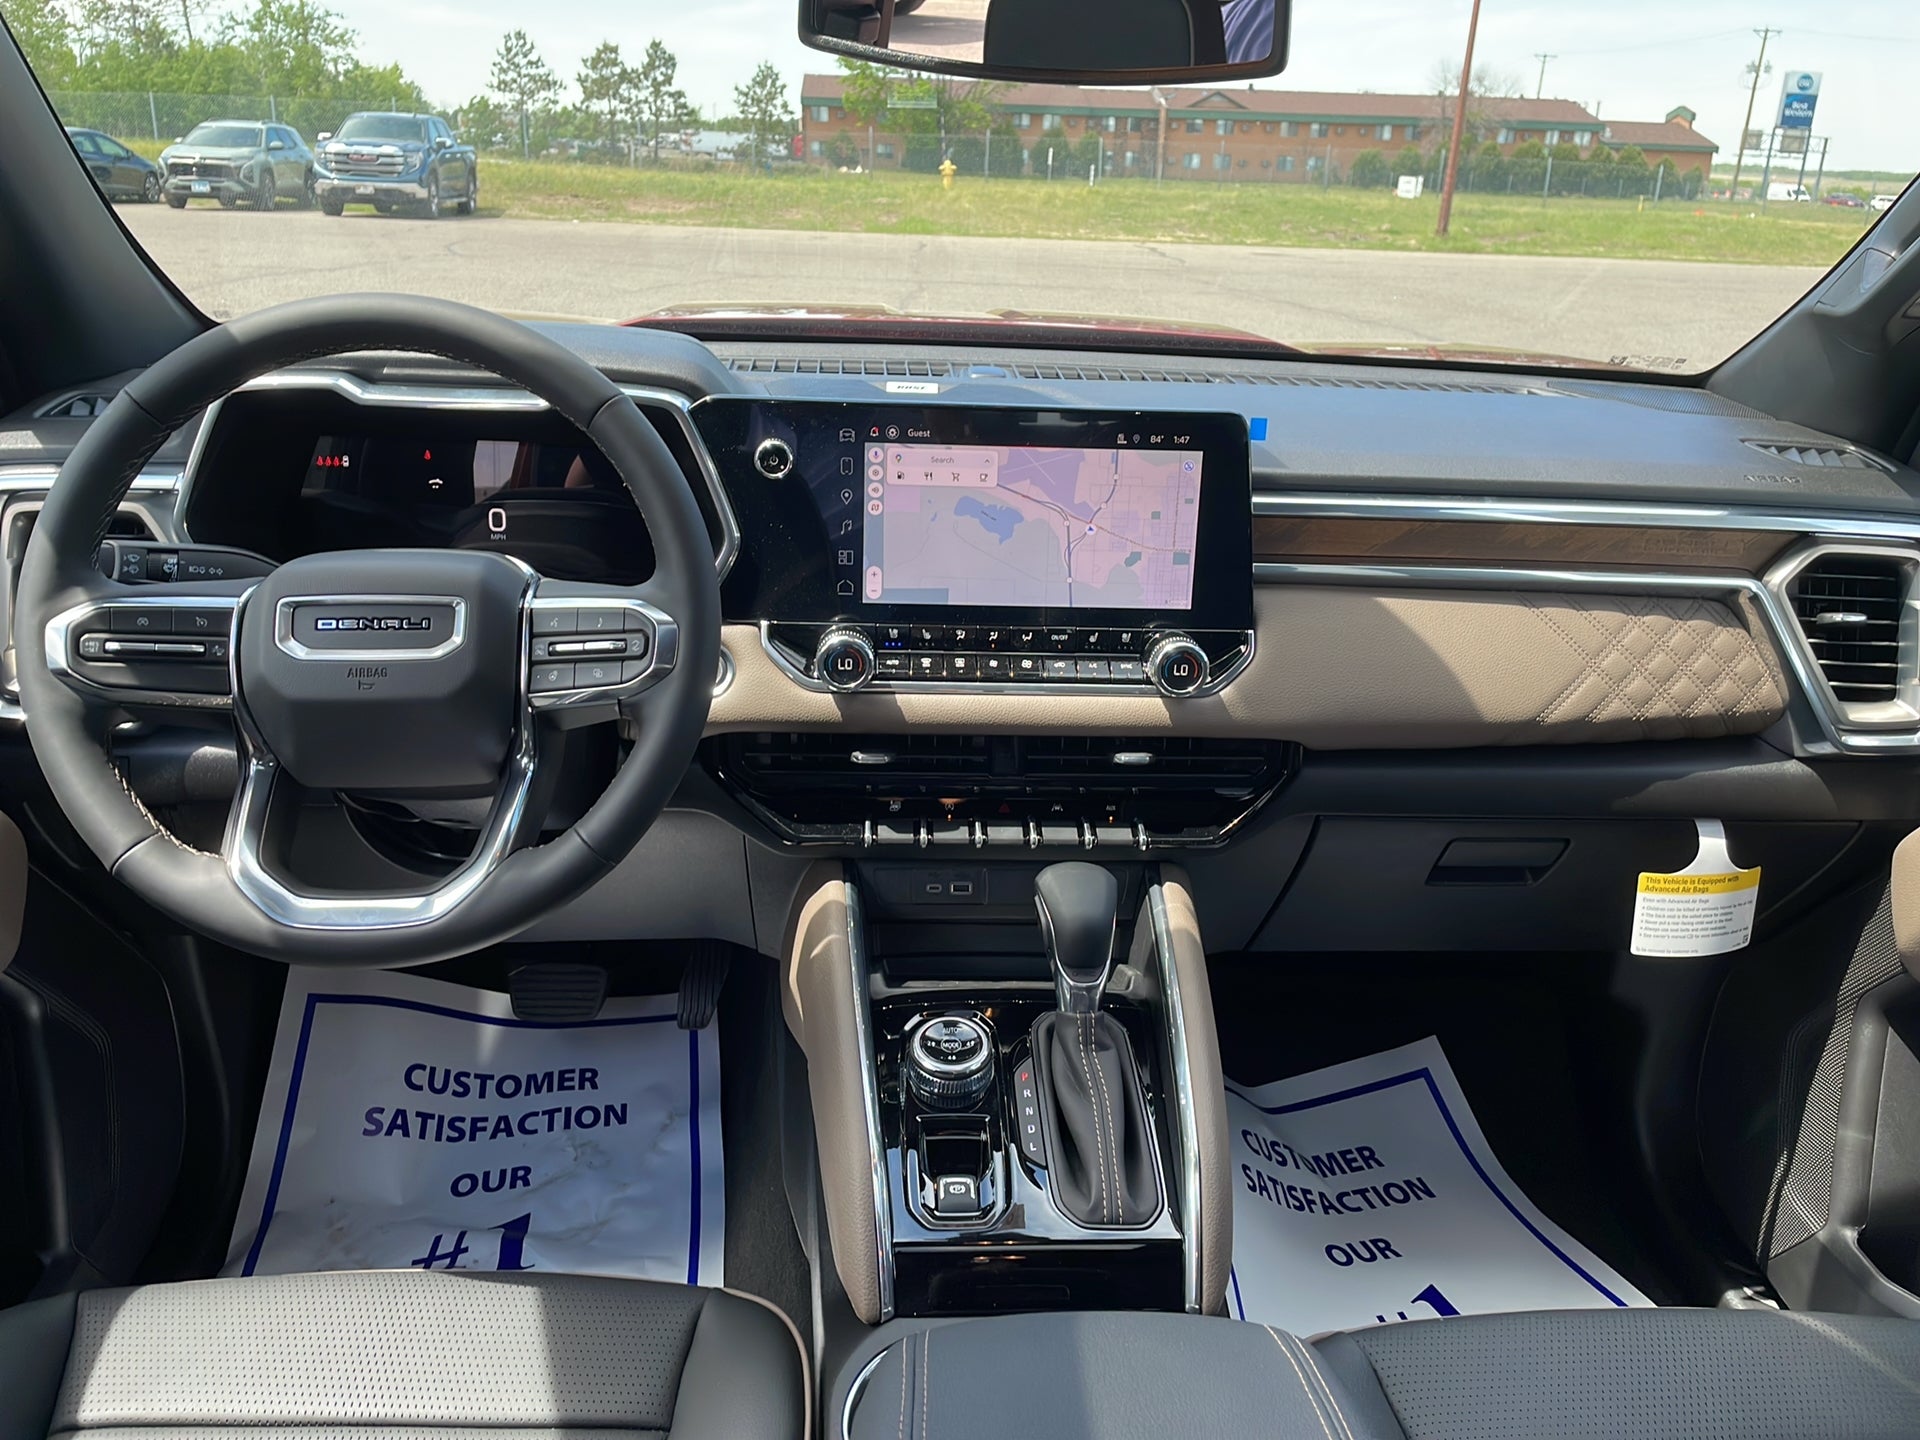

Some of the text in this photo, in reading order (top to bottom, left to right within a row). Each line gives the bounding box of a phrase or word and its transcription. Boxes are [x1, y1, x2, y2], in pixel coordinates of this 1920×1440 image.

[907, 428, 931, 438] Guest
[1173, 435, 1190, 444] 1:47
[930, 456, 955, 464] Search
[488, 507, 507, 532] 0
[315, 617, 431, 631] DENALI
[837, 658, 853, 671] LO
[1173, 664, 1189, 677] LO
[347, 667, 388, 679] AIRBAG
[1663, 877, 1689, 886] Vehicle
[1697, 877, 1727, 886] Equipped
[1644, 885, 1680, 893] Advanced
[1692, 886, 1709, 894] Bags
[403, 1063, 599, 1099] CUSTOMER
[1021, 1072, 1028, 1081] P
[1024, 1089, 1032, 1098] R
[1026, 1106, 1034, 1115] N
[362, 1103, 628, 1143] SATISFACTION
[1028, 1125, 1036, 1134] D
[1030, 1143, 1037, 1151] L
[1241, 1129, 1385, 1178] CUSTOMER
[450, 1166, 532, 1197] OUR
[1241, 1163, 1437, 1215] SATISFACTION
[1324, 1238, 1402, 1267] OUR
